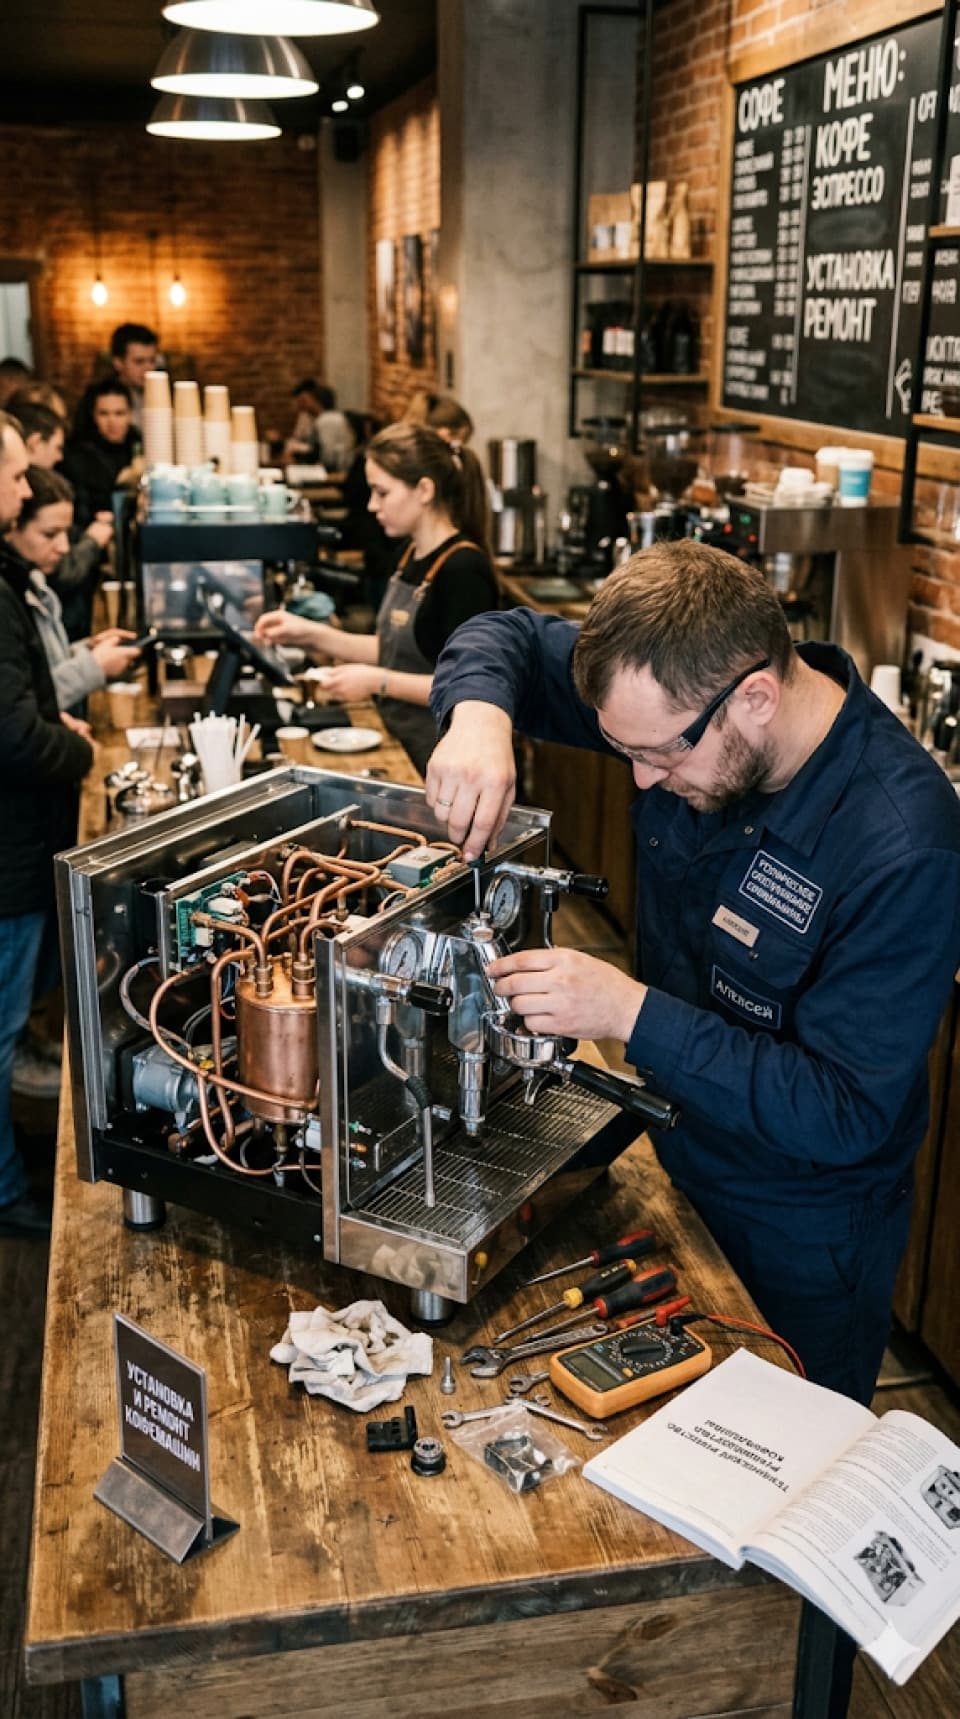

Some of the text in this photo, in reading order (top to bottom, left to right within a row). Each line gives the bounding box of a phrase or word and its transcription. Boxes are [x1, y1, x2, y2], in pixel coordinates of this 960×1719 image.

[823, 38, 907, 113] МЕНЮ:
[815, 112, 873, 169] КОФЕ
[806, 249, 896, 290] УСТАНОВКА
[804, 297, 876, 343] РЕМОНТ
[127, 1360, 194, 1422] УСТАНОВКА
[133, 1387, 190, 1441] И РЕМОНТ
